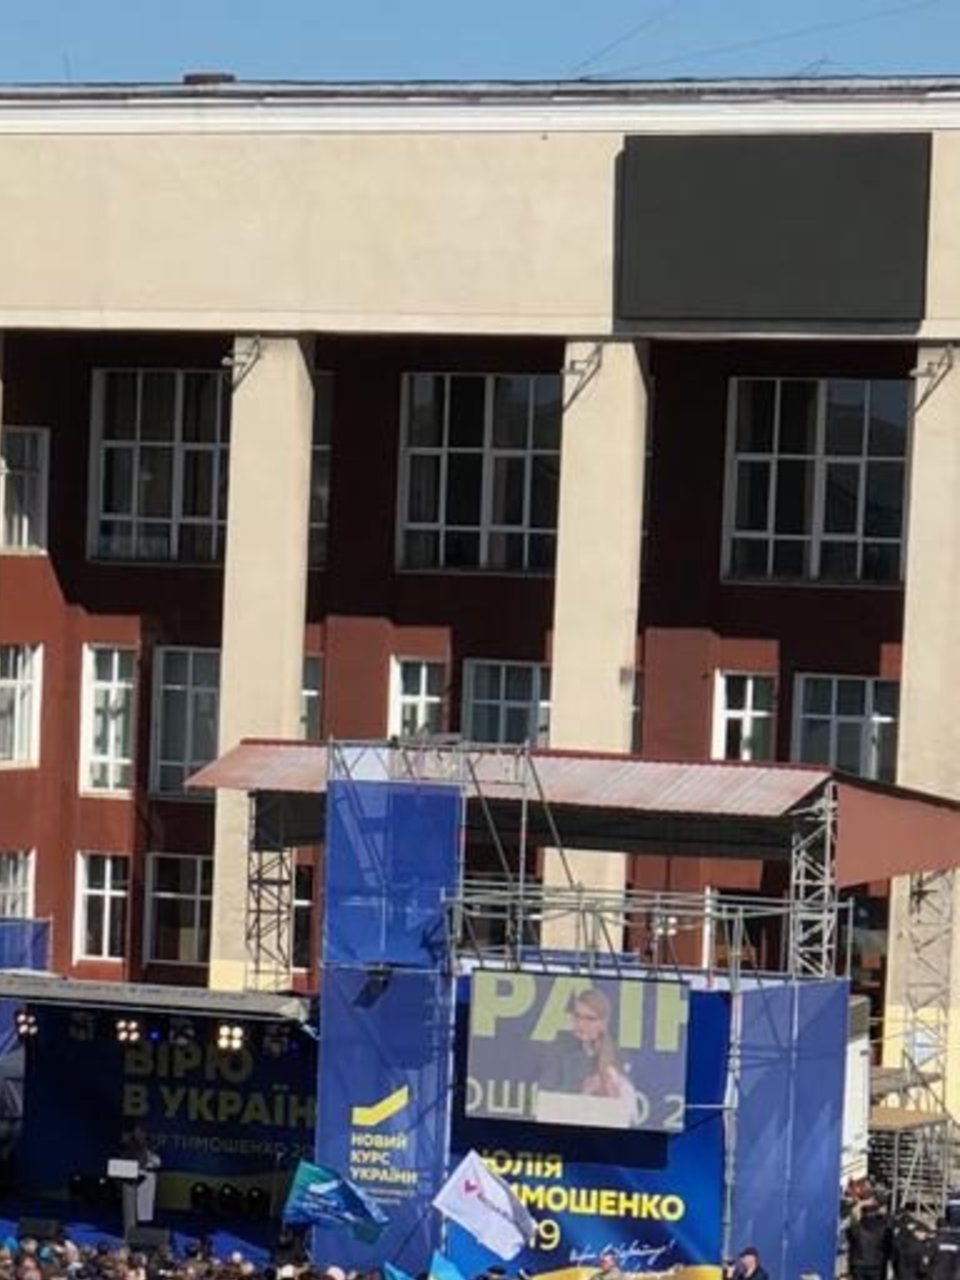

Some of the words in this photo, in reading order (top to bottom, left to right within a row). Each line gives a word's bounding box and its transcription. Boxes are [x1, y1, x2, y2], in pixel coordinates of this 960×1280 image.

[123, 1041, 254, 1083] ВІРЮ
[123, 1083, 149, 1117] В
[352, 1132, 408, 1150] НОВИЙ
[350, 1150, 391, 1166] КУРС
[349, 1166, 418, 1184] УКРАЇНИ
[510, 1183, 685, 1222] МОШЕНКО
